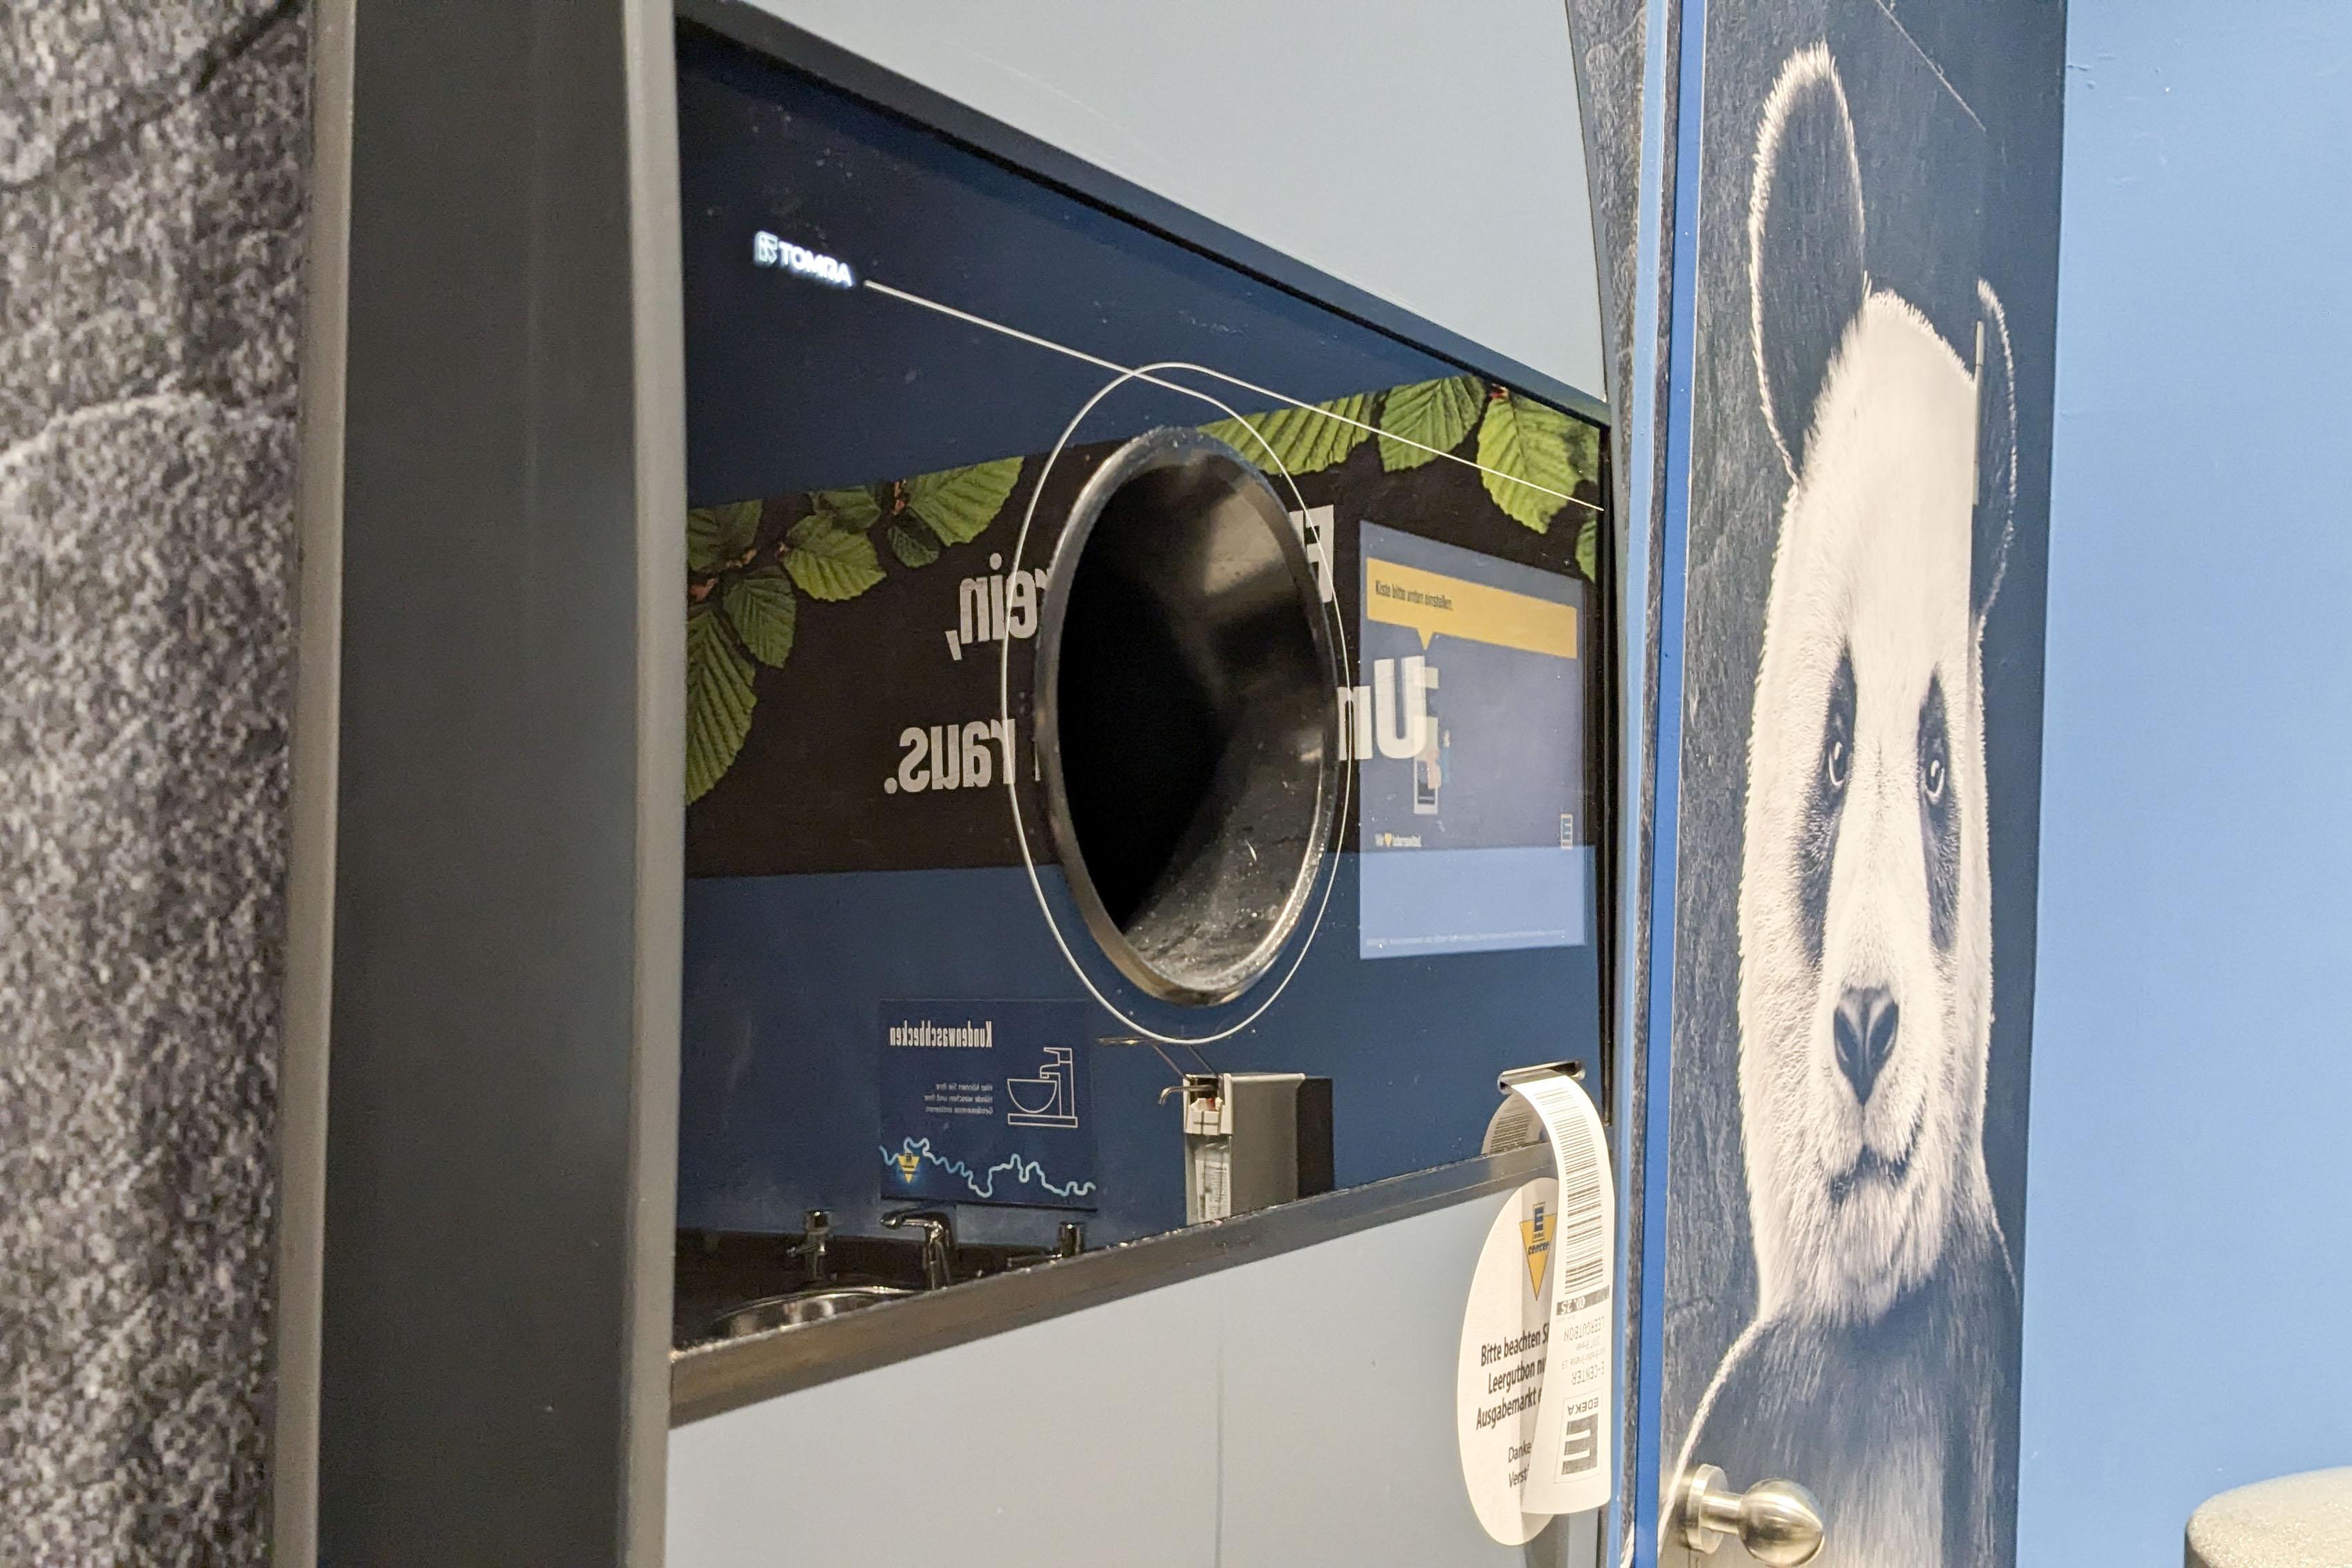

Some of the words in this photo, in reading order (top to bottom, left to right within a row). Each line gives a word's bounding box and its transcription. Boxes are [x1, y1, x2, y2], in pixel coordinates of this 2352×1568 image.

[779, 241, 852, 287] TOMRA
[1564, 1316, 1605, 1341] LEERGUTBON
[1481, 1343, 1502, 1366] Bitte
[1504, 1329, 1540, 1358] beachten
[1488, 1360, 1535, 1394] Leergutbon
[1571, 1361, 1605, 1385] E-CENTER
[1476, 1386, 1536, 1430] Ausgabemarkt
[1567, 1397, 1599, 1416] EDEKA
[1509, 1439, 1531, 1463] Danke
